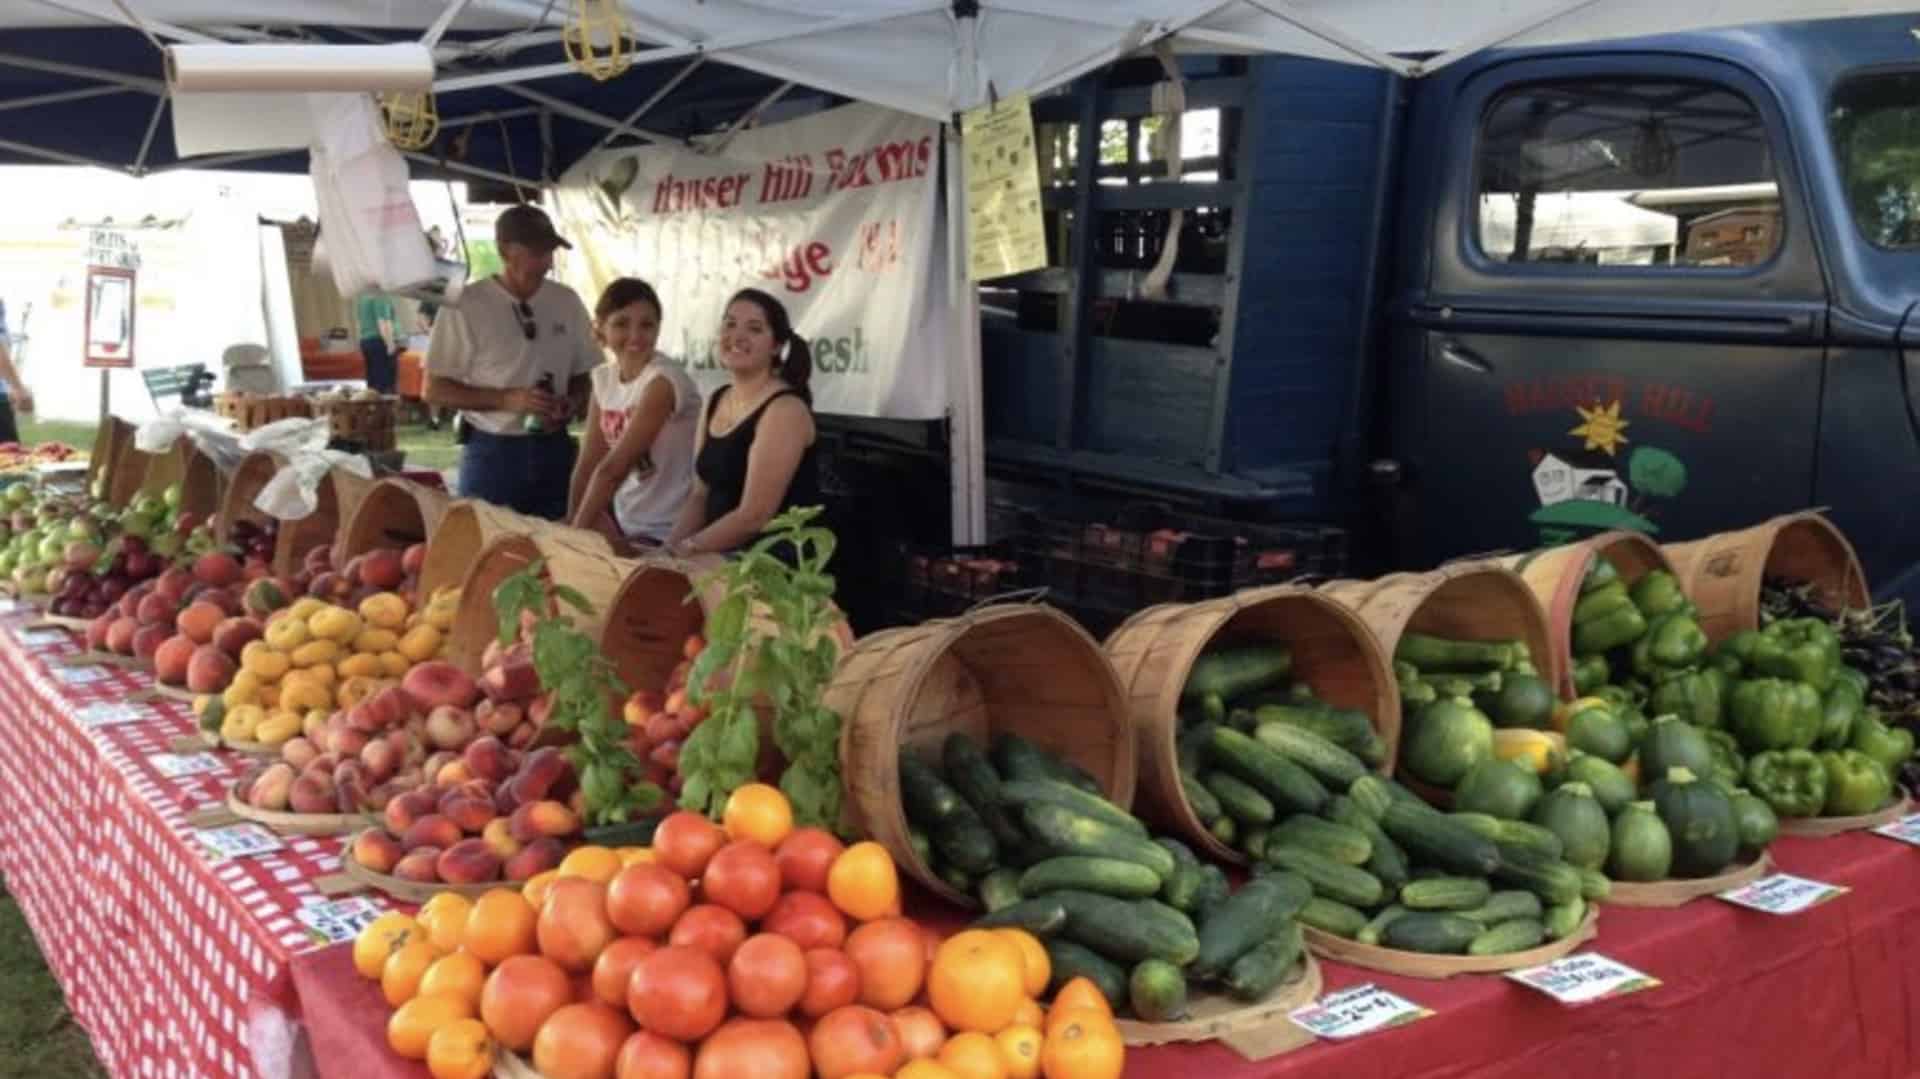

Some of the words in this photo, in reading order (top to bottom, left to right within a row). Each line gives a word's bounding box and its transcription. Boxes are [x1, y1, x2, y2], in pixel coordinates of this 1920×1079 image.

[651, 173, 750, 214] Hauser
[759, 153, 814, 204] Hill
[823, 134, 932, 195] Farms
[1504, 374, 1627, 417] HAUSER
[1640, 383, 1718, 433] HILL
